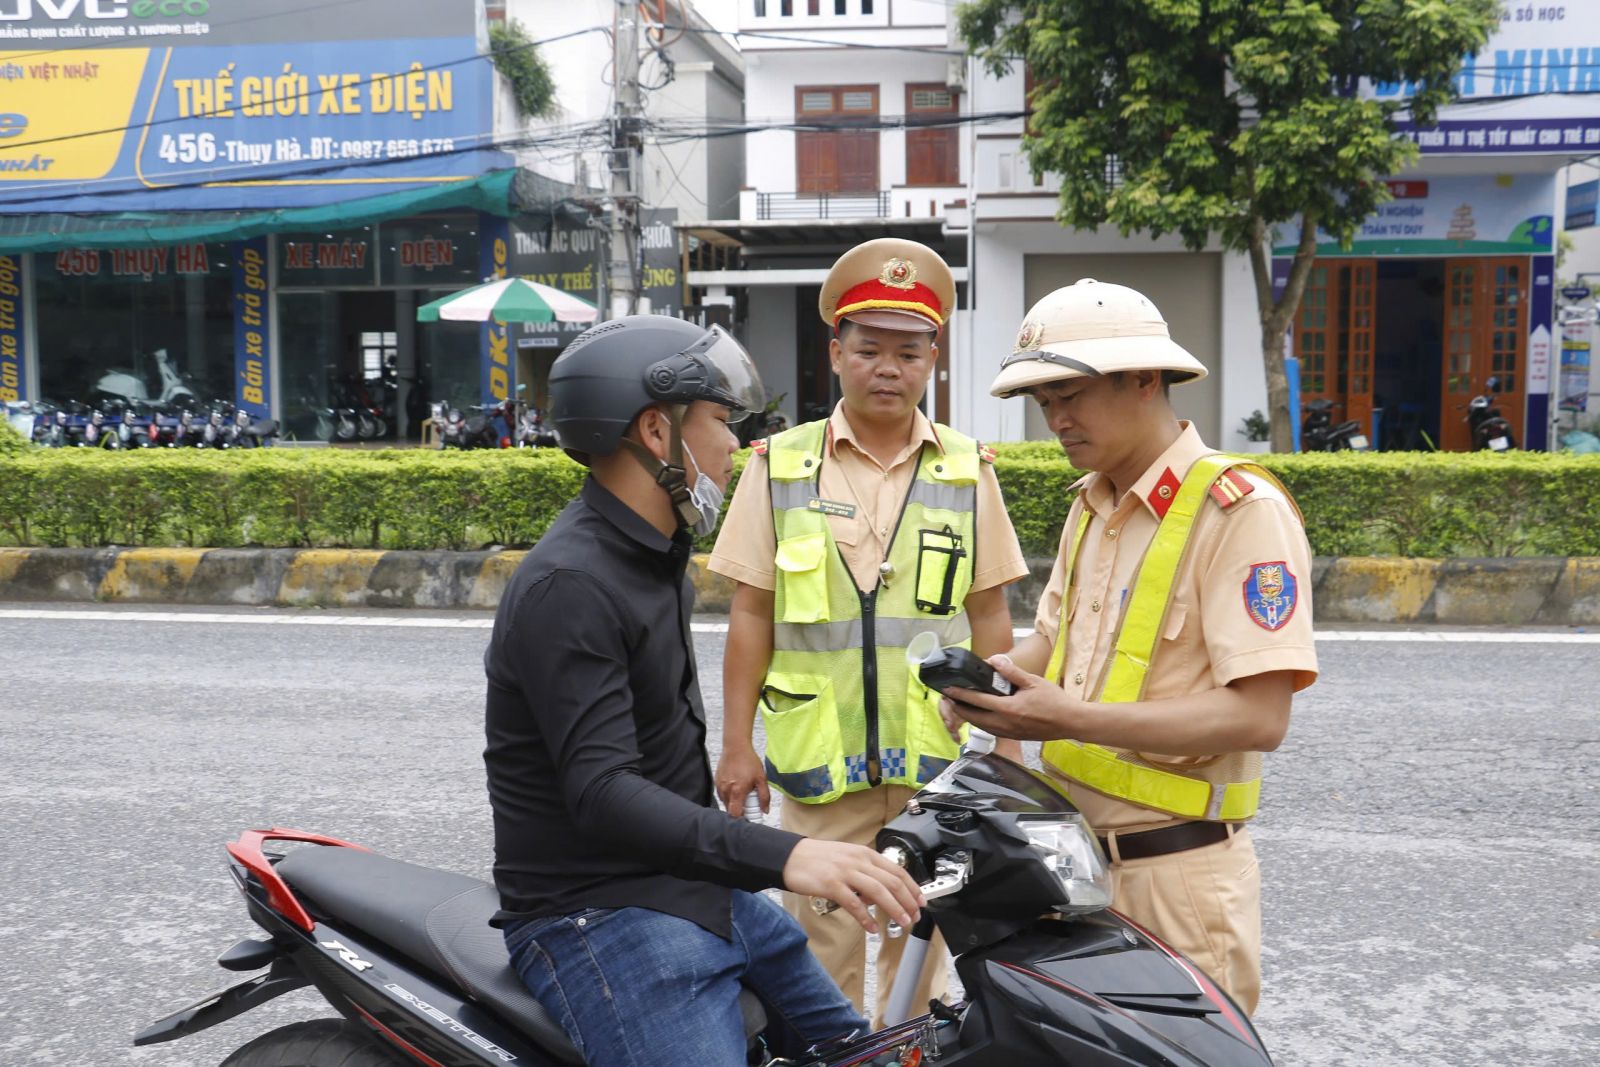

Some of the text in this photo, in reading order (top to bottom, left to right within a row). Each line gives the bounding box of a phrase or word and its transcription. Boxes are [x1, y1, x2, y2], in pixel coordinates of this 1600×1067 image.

[58, 24, 87, 38] CHẤT
[88, 26, 126, 39] LƯỢNG
[128, 25, 137, 36] &
[1538, 7, 1566, 23] HỌC
[29, 61, 59, 82] VIỆT
[63, 61, 99, 82] NHẬT
[1493, 47, 1600, 97] MINH
[173, 61, 454, 120] THẾ GIỚI XE ĐIỆN
[159, 132, 217, 163] 456
[55, 246, 100, 276] 456
[110, 246, 168, 282] THỤY
[285, 238, 367, 269] XE MÁY
[400, 234, 454, 271] ĐIỆN
[235, 249, 266, 404] Bán xe trả góp
